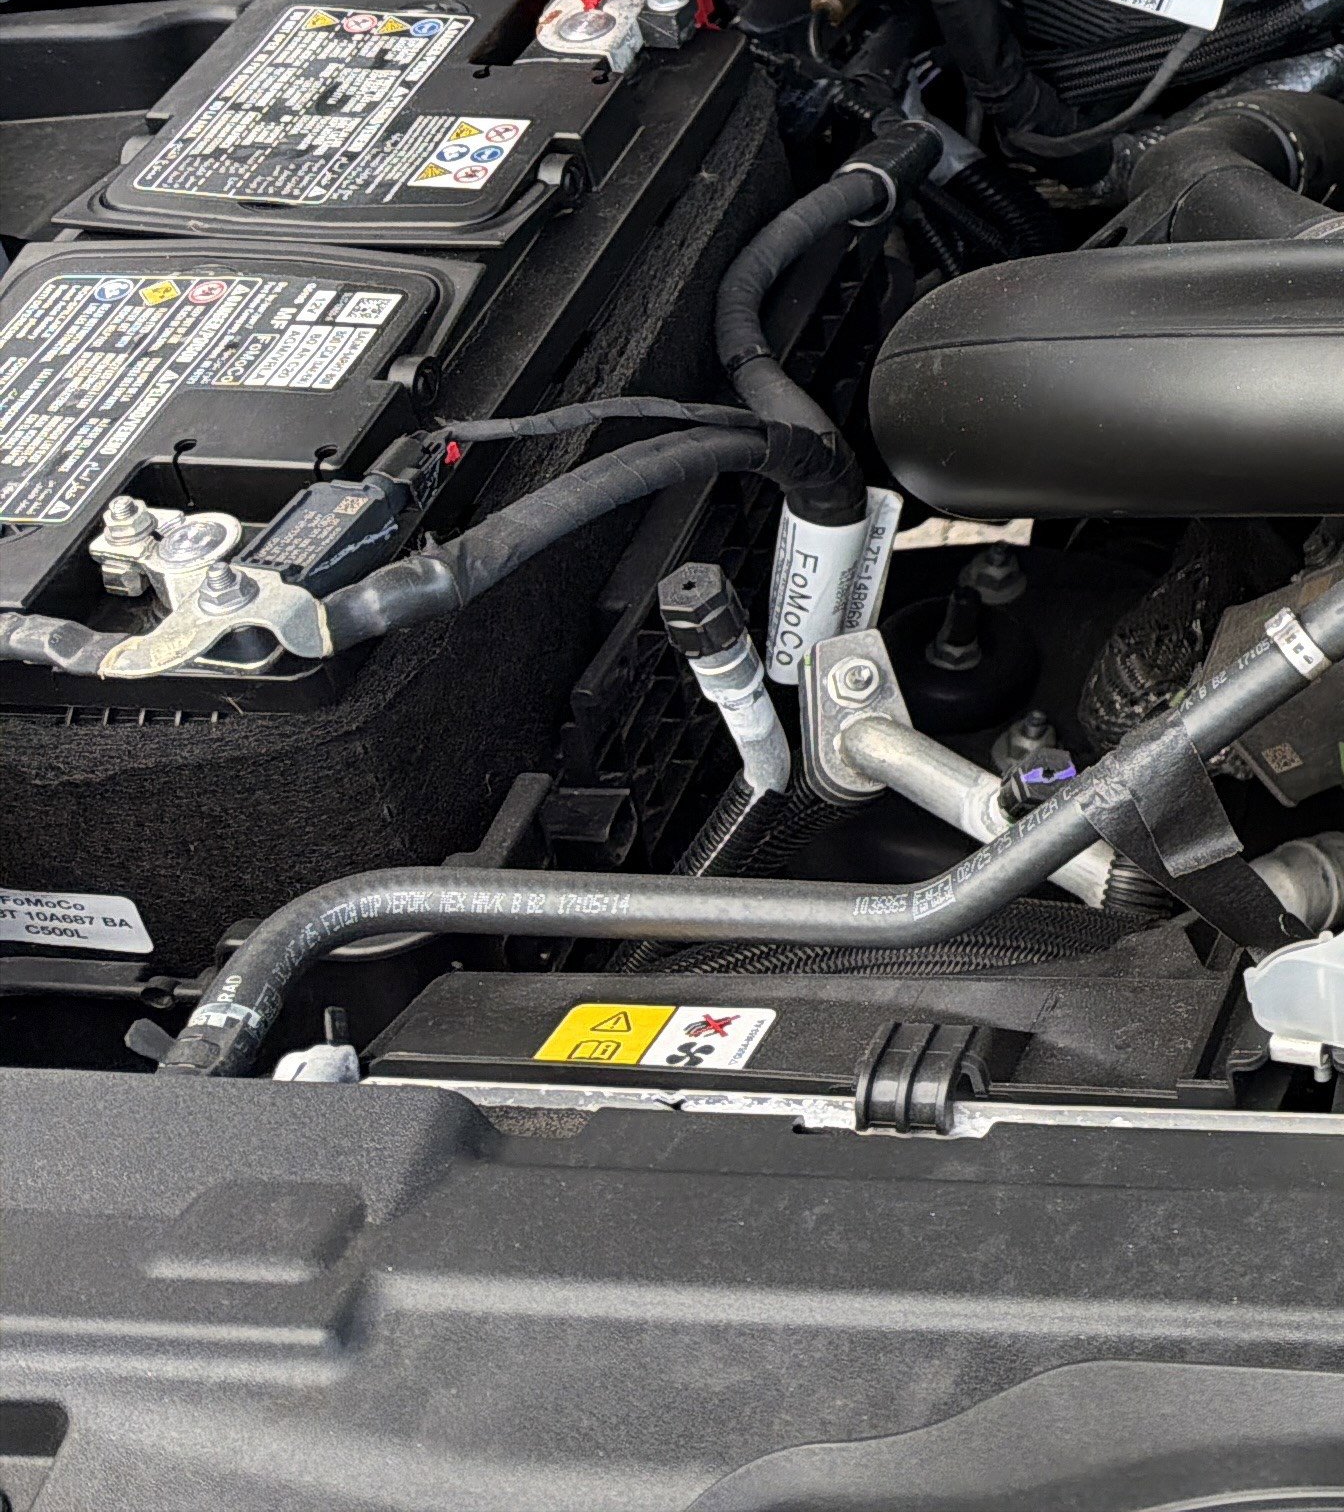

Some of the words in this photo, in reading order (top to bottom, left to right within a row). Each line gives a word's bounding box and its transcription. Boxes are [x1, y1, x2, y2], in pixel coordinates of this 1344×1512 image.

[264, 306, 299, 329] MF
[217, 334, 273, 383] FoMoCo
[775, 549, 819, 666] FoMoCo
[0, 895, 86, 912] FoMoCo
[25, 911, 95, 926] 10A687
[101, 916, 133, 930] BA
[25, 924, 89, 940] C500L
[217, 974, 242, 1003] RAD
